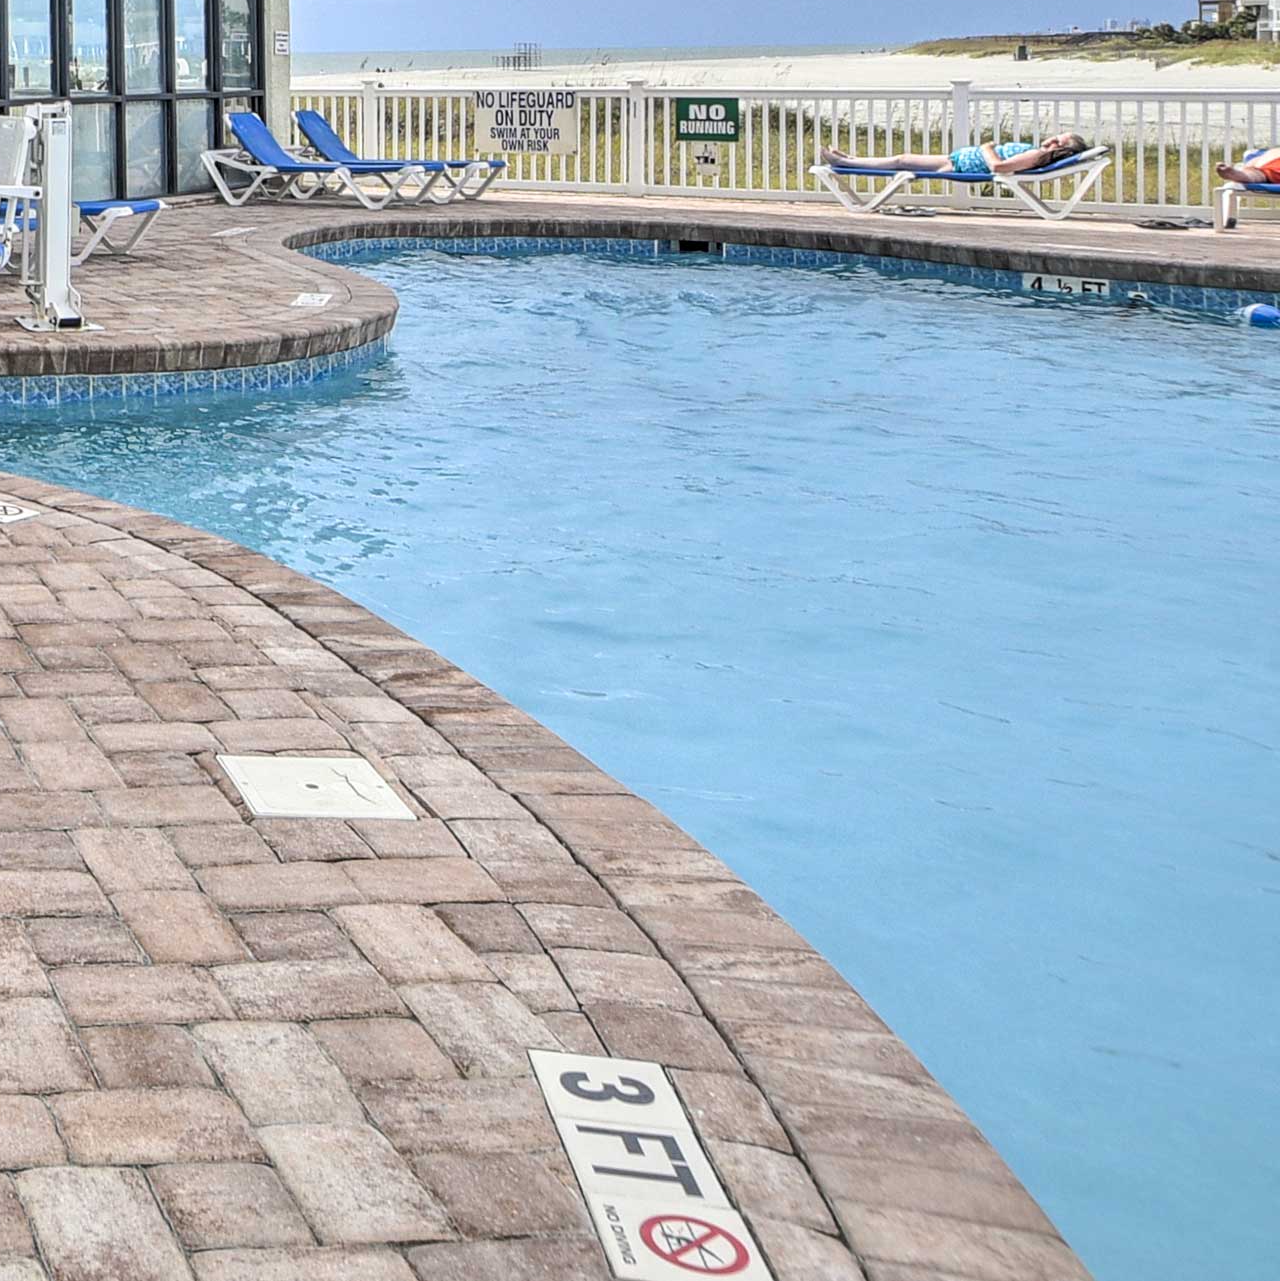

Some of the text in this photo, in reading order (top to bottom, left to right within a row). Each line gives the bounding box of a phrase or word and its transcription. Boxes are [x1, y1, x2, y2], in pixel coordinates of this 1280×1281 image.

[476, 91, 575, 109] NO LIFEGUARD
[495, 109, 554, 127] ON DUTY
[688, 104, 726, 120] NO
[490, 127, 560, 140] SWIM AT YOUR
[679, 120, 736, 135] RUNNING
[501, 139, 549, 152] OWN RISK
[558, 1071, 705, 1199] 3 FT
[603, 1204, 637, 1265] NO DIVING
